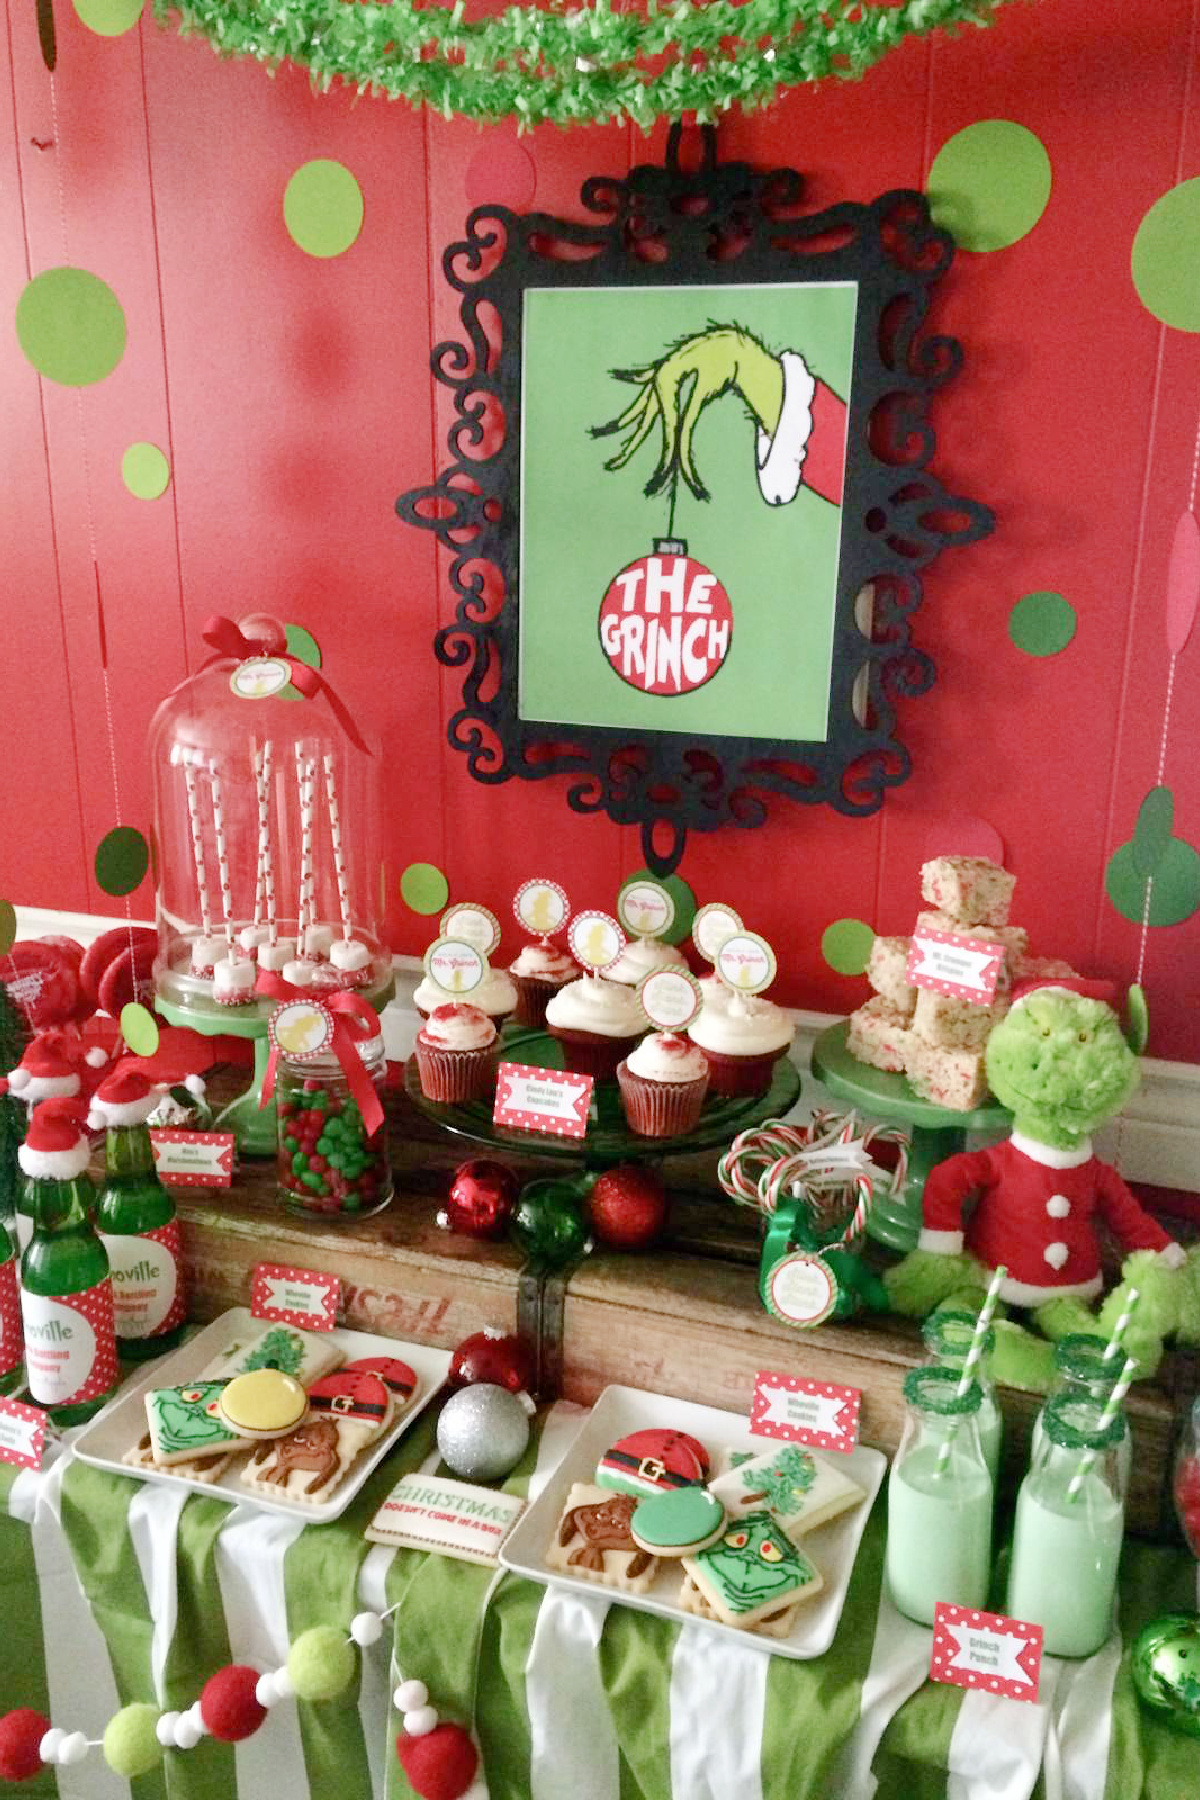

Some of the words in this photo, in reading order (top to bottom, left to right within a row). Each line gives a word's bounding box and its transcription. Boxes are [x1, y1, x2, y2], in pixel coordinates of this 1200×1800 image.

[616, 558, 717, 614] THE
[601, 614, 728, 692] GRINCH
[391, 1485, 513, 1523] CHRISTMAS
